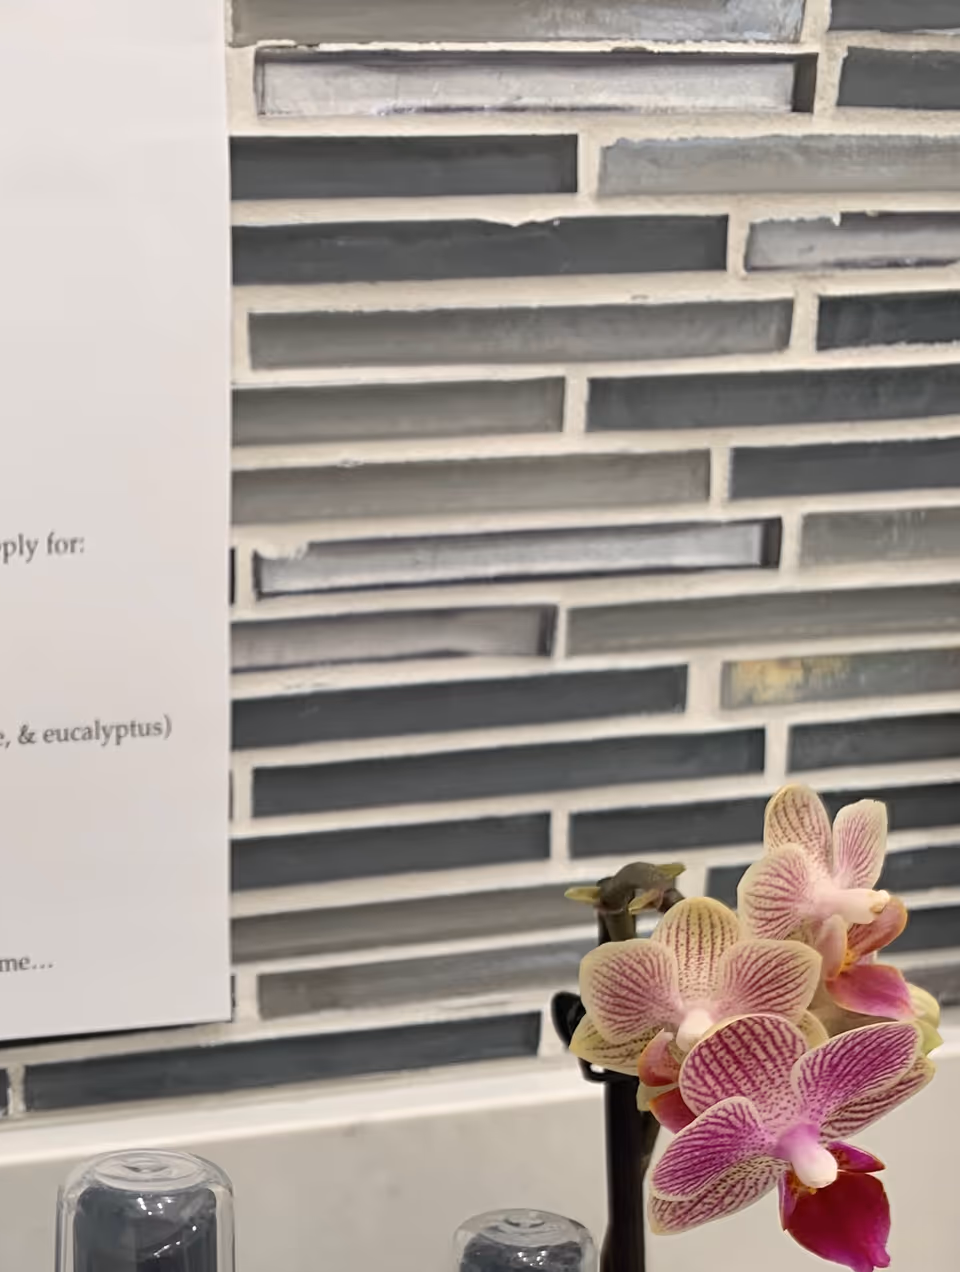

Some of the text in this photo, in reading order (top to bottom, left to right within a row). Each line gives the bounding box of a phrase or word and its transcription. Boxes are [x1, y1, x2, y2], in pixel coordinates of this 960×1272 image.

[47, 532, 84, 554] for:
[18, 725, 36, 745] &
[43, 715, 171, 746] eucalyptus)
